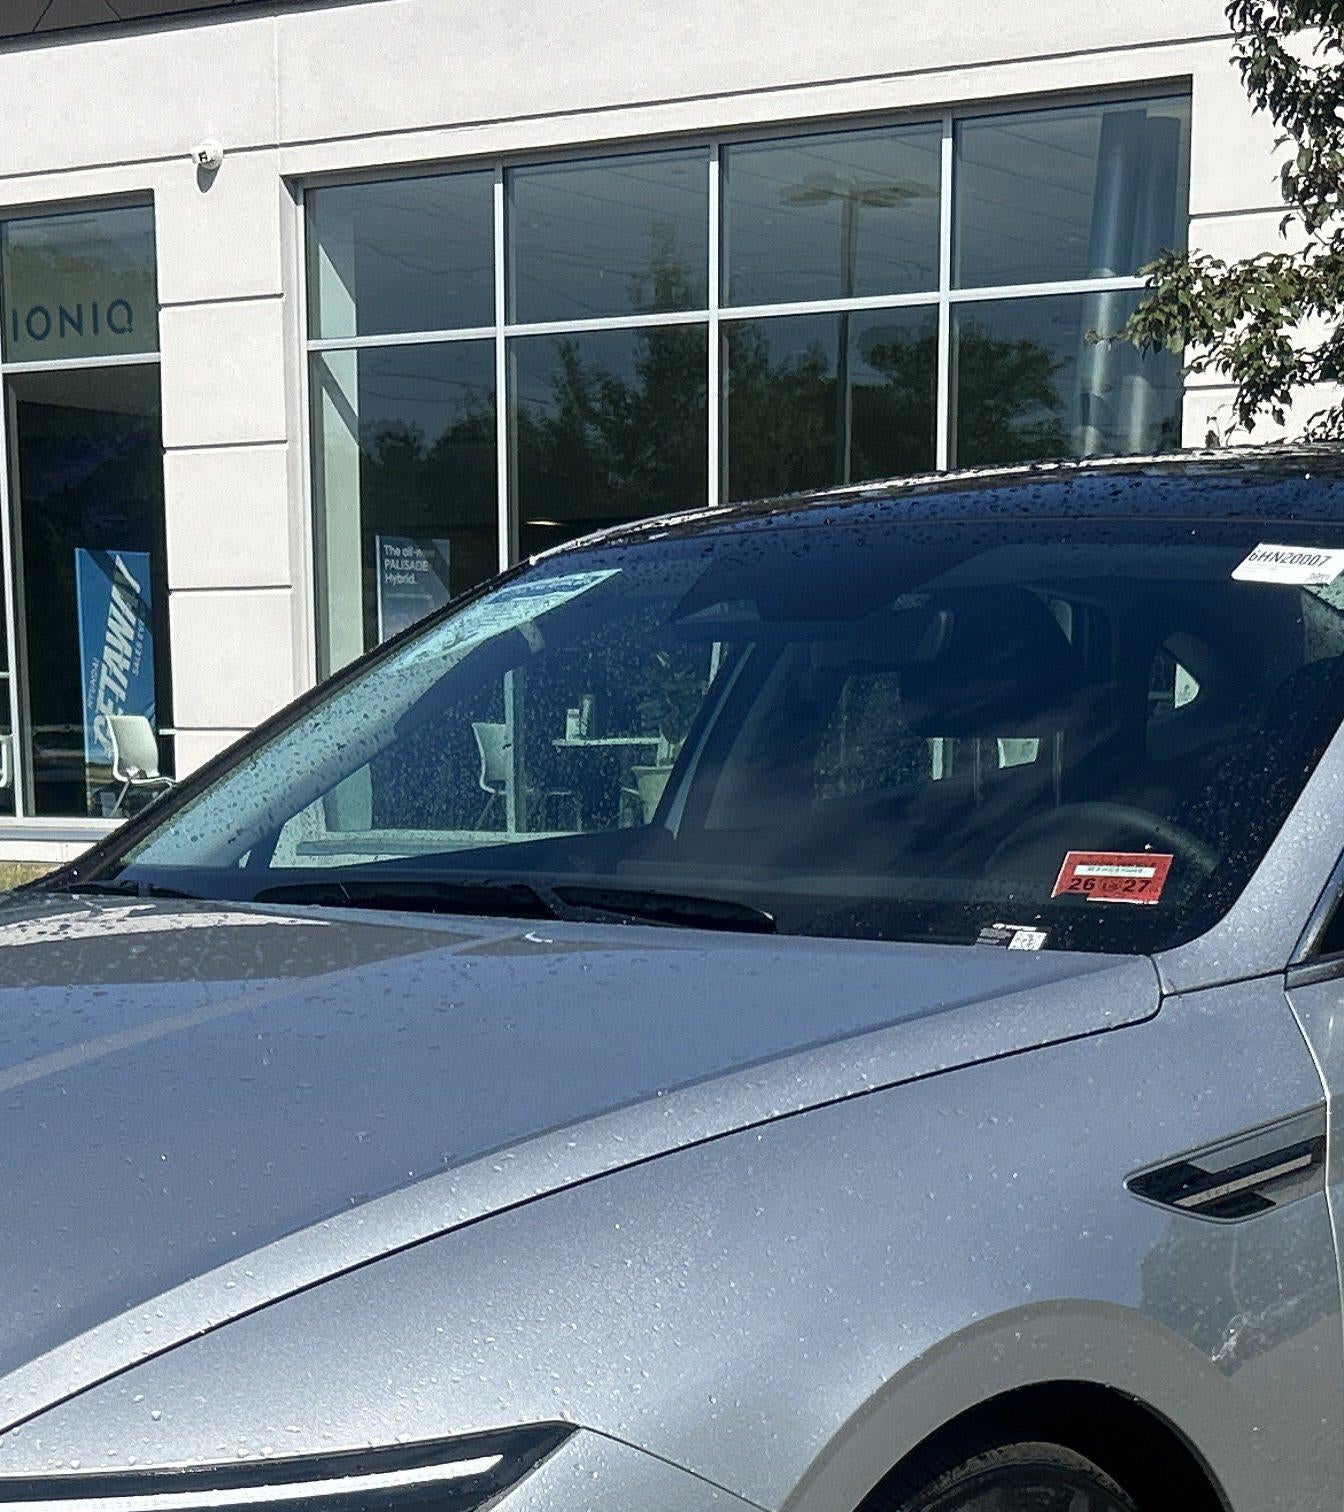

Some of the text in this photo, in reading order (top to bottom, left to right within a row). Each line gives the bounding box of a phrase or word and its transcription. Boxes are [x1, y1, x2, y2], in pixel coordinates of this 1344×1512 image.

[12, 299, 133, 342] IONIQ
[384, 559, 429, 572] PALISADE
[1068, 878, 1096, 891] 26
[1122, 880, 1151, 893] 27
